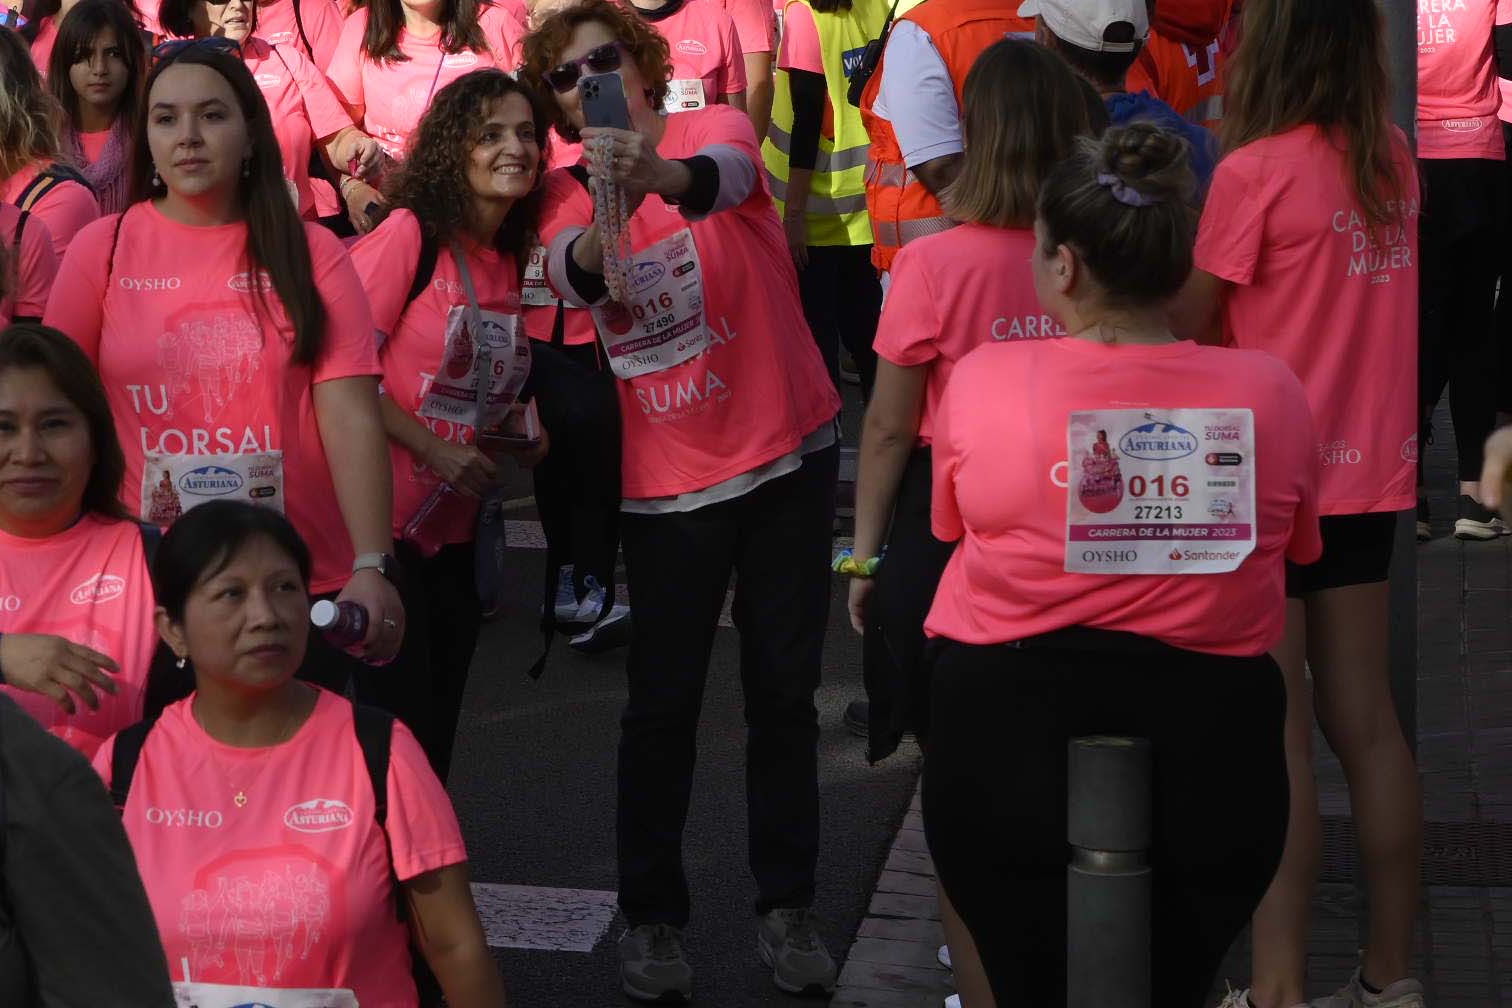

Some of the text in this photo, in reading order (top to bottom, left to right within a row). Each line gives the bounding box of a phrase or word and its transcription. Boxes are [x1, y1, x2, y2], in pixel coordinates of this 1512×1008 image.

[1348, 247, 1413, 277] MUJER
[120, 276, 181, 292] OYSHO
[632, 292, 673, 320] 016
[642, 313, 675, 334] 27490
[622, 354, 659, 370] OYSHO
[127, 383, 169, 415] TU
[636, 369, 727, 414] SUMA
[1205, 431, 1240, 441] SUMA
[1124, 439, 1192, 452] ASTURIANA
[184, 474, 240, 490] ASTURIANA
[1129, 475, 1190, 497] 016
[1134, 506, 1183, 520] 27213
[1088, 528, 1237, 537] CARRERA DE LA MUJER 2023
[1082, 550, 1240, 562] OYSHO Santander
[146, 808, 223, 829] OYSHO
[289, 810, 348, 826] ASTURIANA
